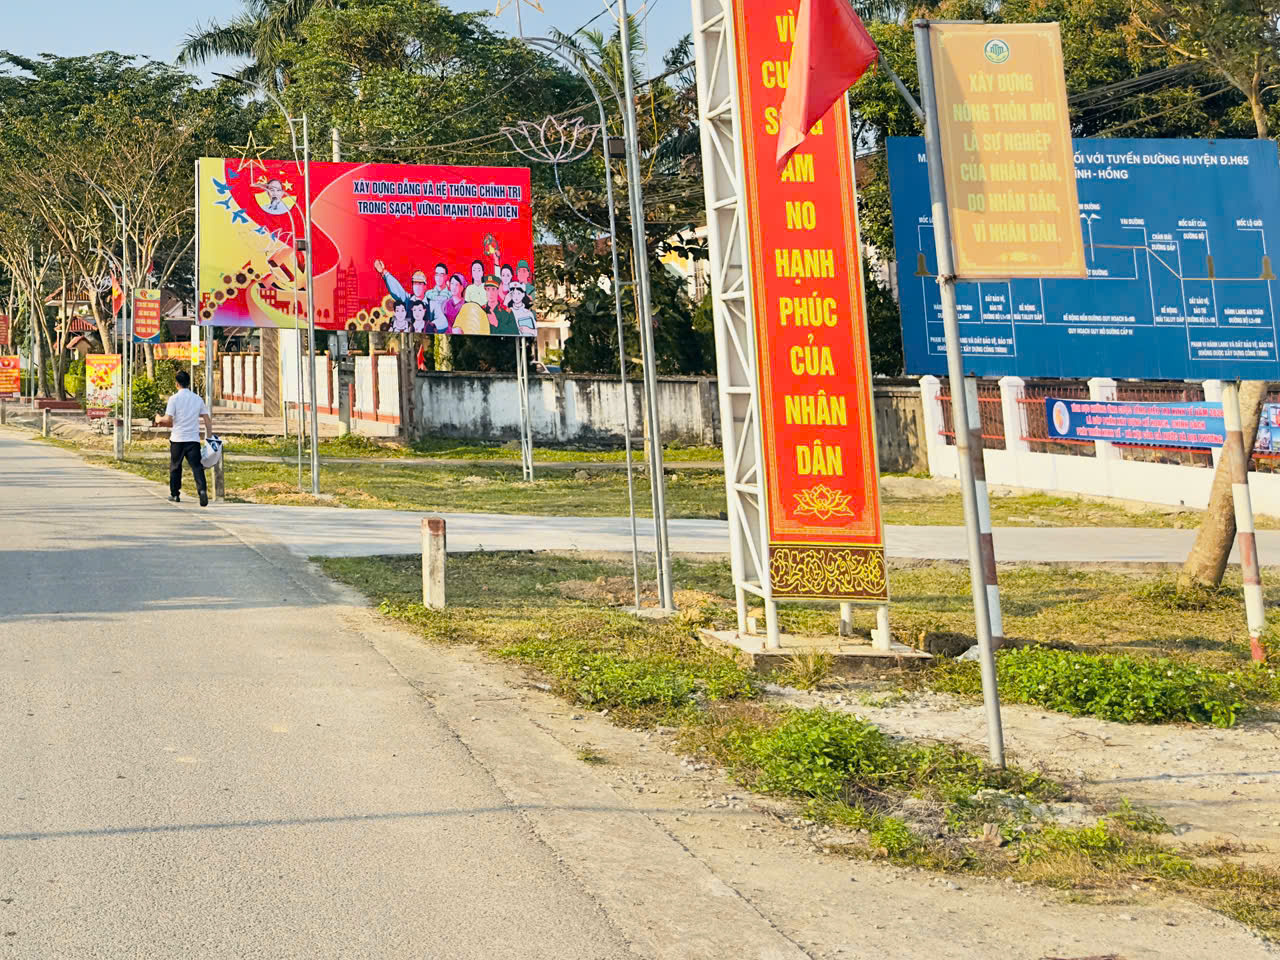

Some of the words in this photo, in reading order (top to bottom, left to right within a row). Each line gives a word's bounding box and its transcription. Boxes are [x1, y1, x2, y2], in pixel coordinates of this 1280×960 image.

[969, 71, 993, 92] XÂY
[998, 72, 1033, 96] DỰNG
[953, 99, 990, 121] NÔNG
[992, 99, 1027, 121] THÔN
[963, 129, 978, 152] LÀ
[983, 131, 1001, 154] SỰ
[1004, 129, 1051, 154] NGHIỆP
[960, 156, 987, 181] CỦA
[989, 159, 1027, 181] NHÂN
[1074, 150, 1084, 164] ỐI
[1086, 152, 1104, 164] VỚI
[1106, 151, 1140, 164] TUYẾN
[1142, 152, 1180, 165] ĐƯỜNG
[1182, 153, 1217, 167] HUYỆN
[353, 178, 370, 194] XÂY
[372, 180, 396, 197] DỰNG
[397, 178, 421, 195] ĐẢNG
[422, 180, 434, 195] VÀ
[436, 181, 447, 199] HỆ
[449, 179, 477, 197] THỐNG
[479, 183, 506, 198] CHÍNH
[507, 185, 521, 201] TRỊ
[967, 193, 985, 212] DO
[988, 189, 1026, 213] NHÂN
[358, 201, 387, 215] TRONG
[388, 202, 415, 217] SẠCH,
[417, 200, 440, 216] VỮNG
[442, 203, 469, 219] MẠNH
[471, 202, 495, 217] TOÀN
[497, 203, 518, 220] DIỆN
[785, 200, 816, 231] NO
[974, 220, 986, 242] VÌ
[989, 220, 1026, 243] NHÂN
[775, 248, 834, 286] HẠNH
[779, 291, 837, 327] PHÚC
[790, 333, 834, 377] CỦA
[784, 389, 847, 427] NHÂN
[796, 438, 843, 476] DÂN
